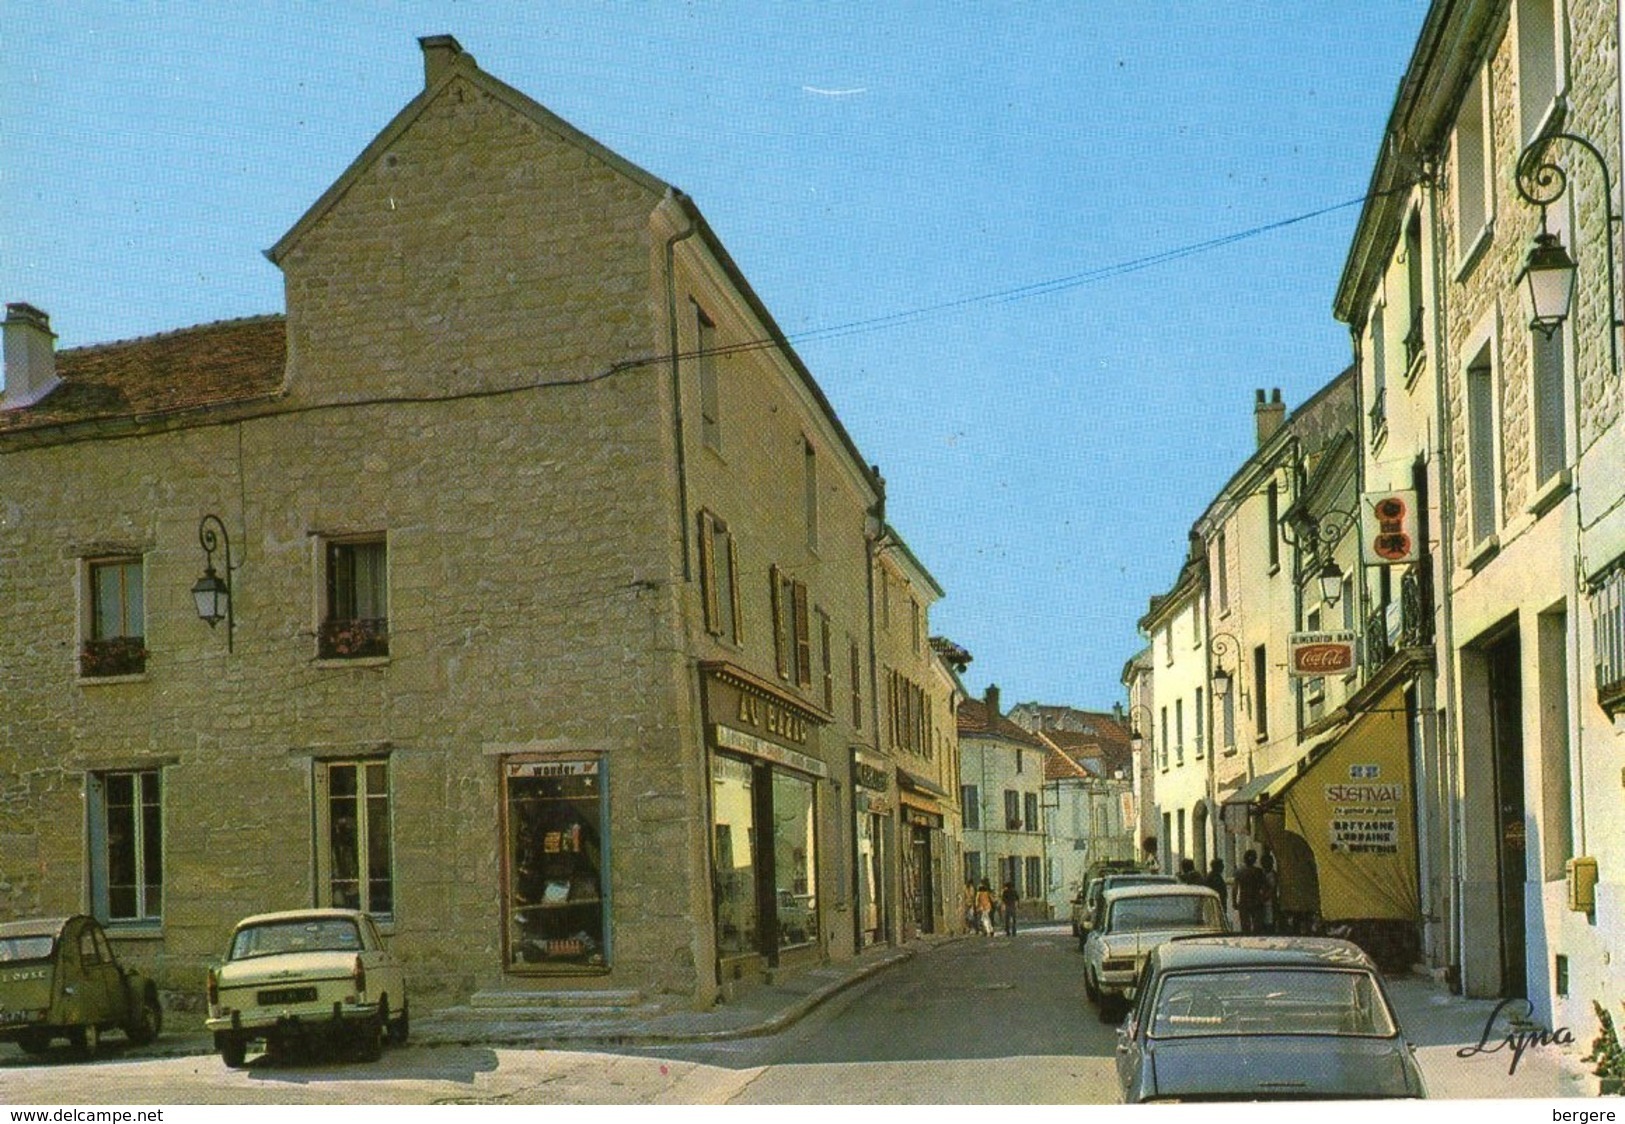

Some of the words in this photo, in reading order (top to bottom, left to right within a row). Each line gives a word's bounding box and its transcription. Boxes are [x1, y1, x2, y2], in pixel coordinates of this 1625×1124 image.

[533, 763, 575, 776] wonder
[1333, 821, 1395, 831] BRETAGNE
[1336, 833, 1391, 842] LORRAINE
